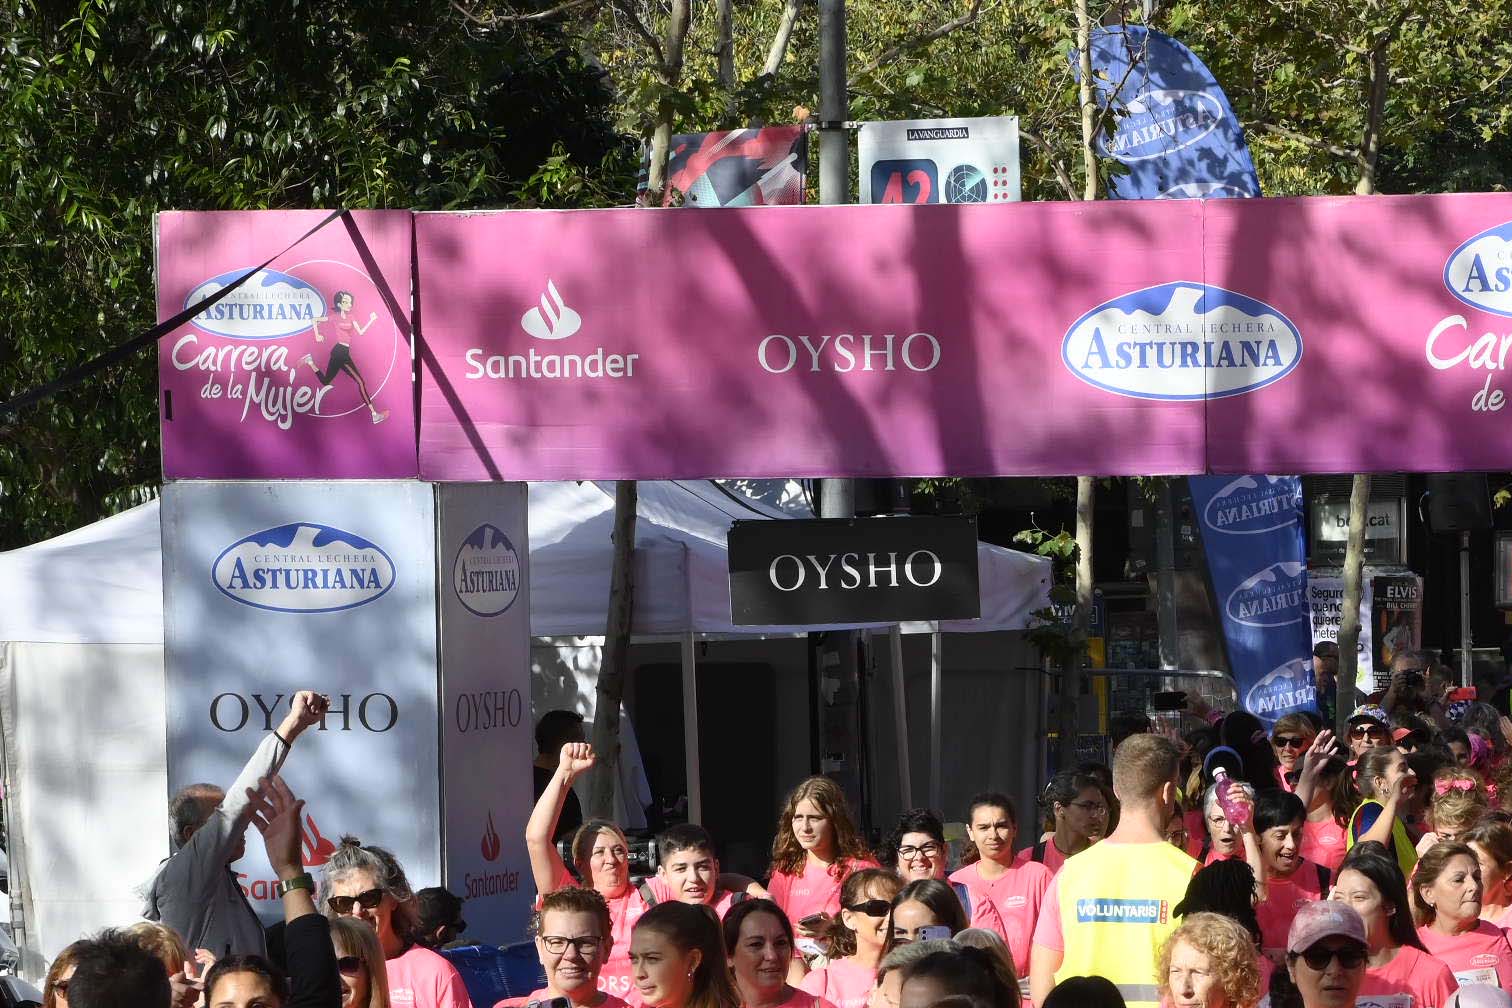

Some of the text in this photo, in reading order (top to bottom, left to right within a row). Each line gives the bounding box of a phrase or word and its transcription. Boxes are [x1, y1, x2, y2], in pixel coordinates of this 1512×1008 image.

[918, 127, 968, 140] VANGUARDIA
[197, 293, 315, 321] ASTURIANA
[1117, 322, 1276, 334] CENTRAL LECHERA
[171, 334, 291, 371] Carrera
[465, 347, 640, 379] Santander
[757, 332, 941, 375] OYSHO
[1081, 327, 1284, 370] ASTURIANA
[201, 368, 334, 430] de la Mujer
[1471, 373, 1506, 412] de
[1336, 513, 1391, 528] b.cat
[226, 557, 383, 590] ASTURIANA
[254, 554, 377, 564] CENTRAL LECHERA
[769, 550, 942, 591] OYSHO
[459, 562, 517, 596] ASTURIANA
[1387, 585, 1417, 598] ELVIS
[1312, 615, 1345, 627] quiere
[209, 692, 399, 733] OYHO
[456, 688, 522, 733] OYSHO
[464, 868, 520, 900] Santander
[1077, 904, 1157, 918] VOLUNTARIS
